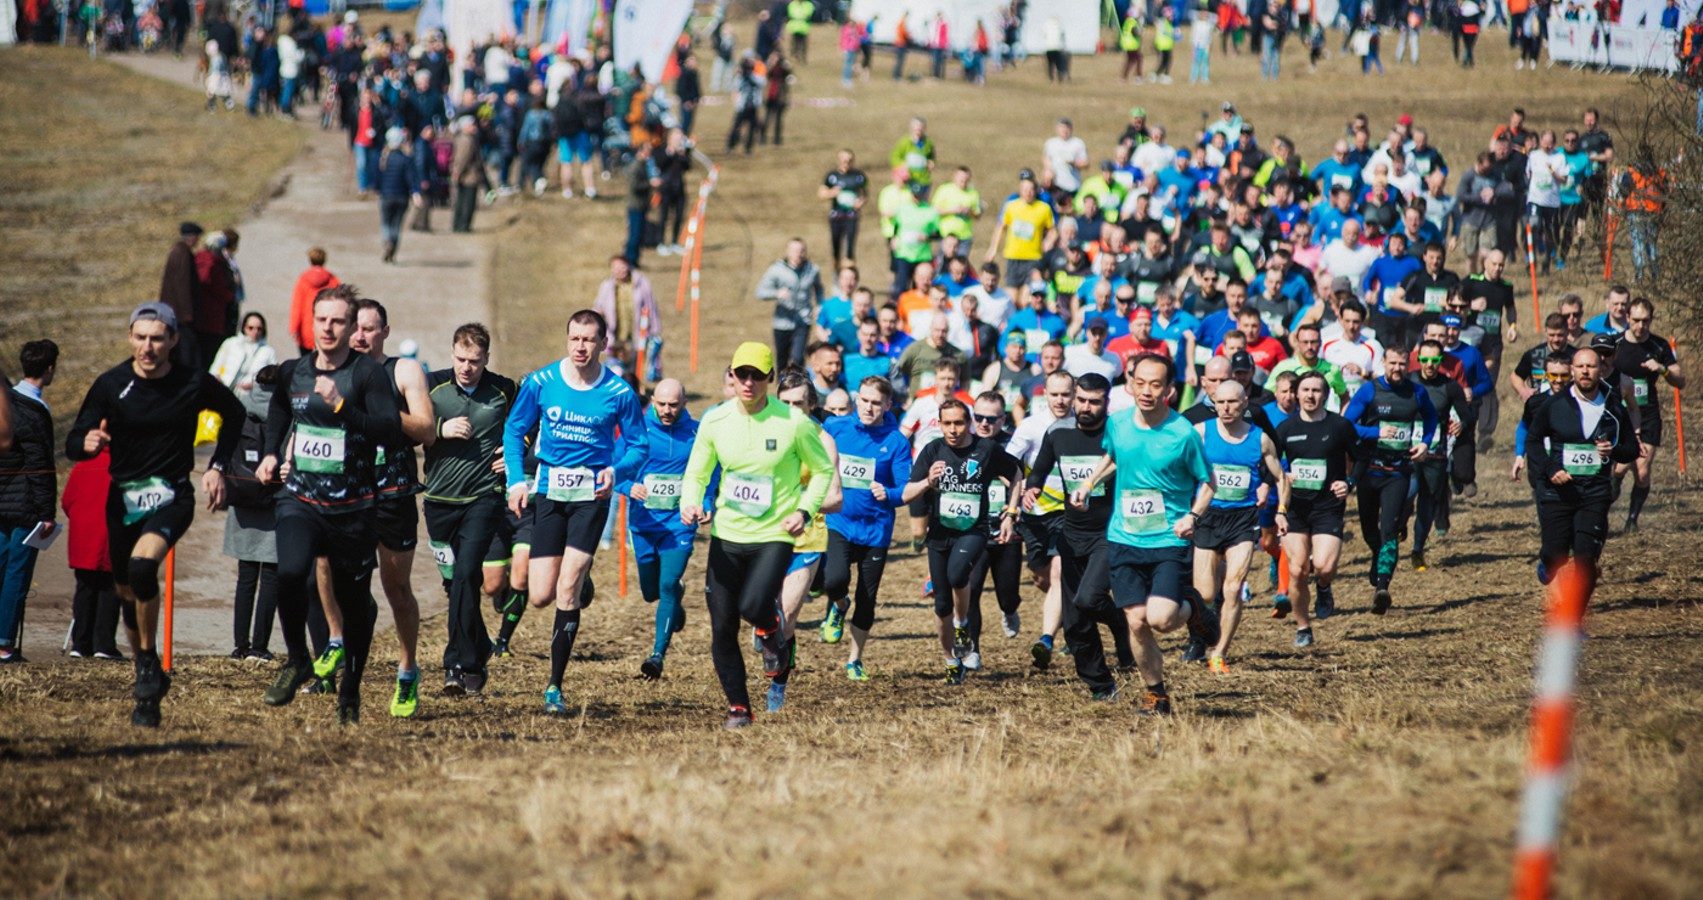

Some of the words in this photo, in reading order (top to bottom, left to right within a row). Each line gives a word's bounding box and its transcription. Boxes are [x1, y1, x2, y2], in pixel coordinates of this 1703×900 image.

[302, 440, 332, 458] 460
[1572, 453, 1593, 464] 496
[843, 465, 866, 478] 429
[1070, 467, 1093, 479] 540
[1298, 468, 1318, 479] 554
[557, 474, 584, 487] 557
[1219, 474, 1241, 487] 562
[652, 483, 675, 495] 428
[733, 485, 760, 501] 404
[939, 482, 983, 493] RUNNERS
[948, 503, 971, 516] 463
[1130, 500, 1154, 515] 432
